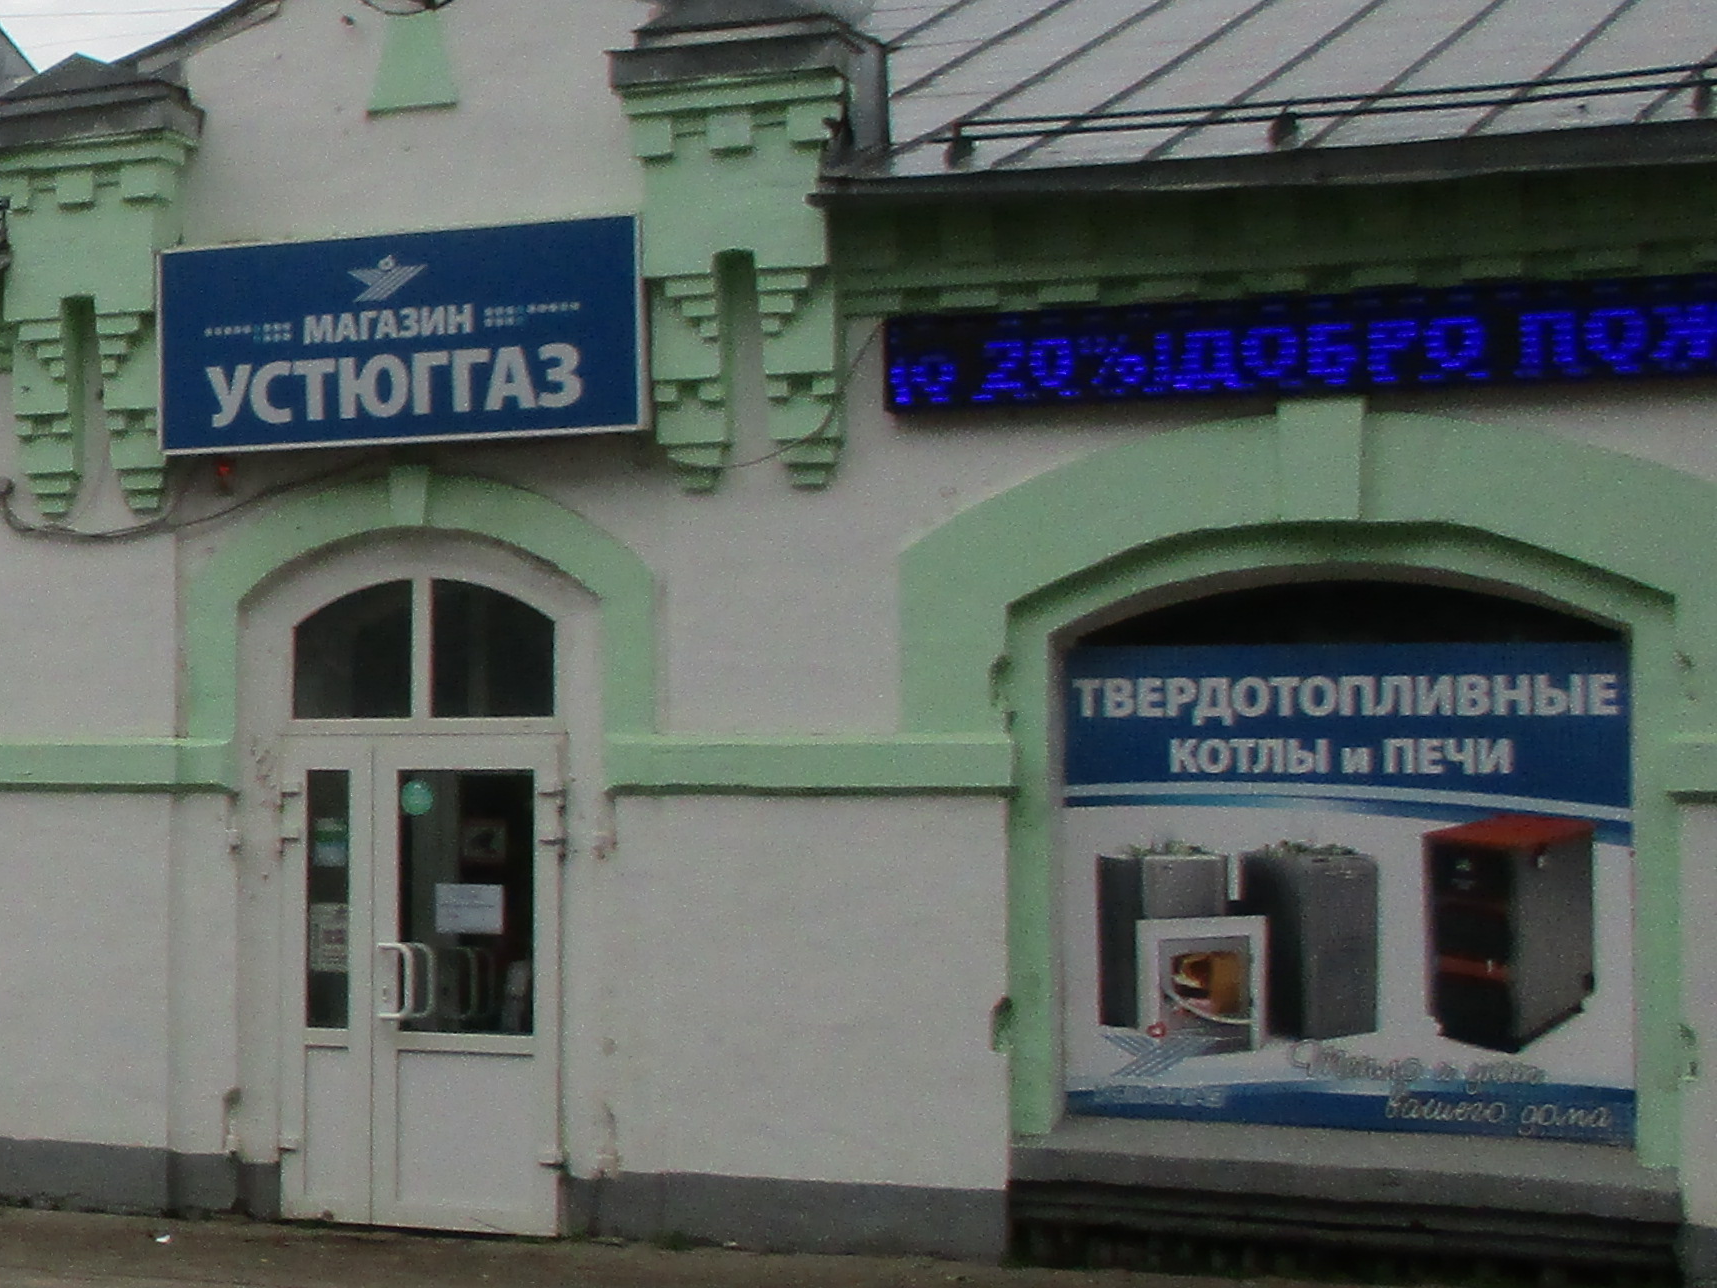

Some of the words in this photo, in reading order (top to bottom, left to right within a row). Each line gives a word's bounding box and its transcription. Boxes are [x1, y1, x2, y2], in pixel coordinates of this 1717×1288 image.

[303, 303, 475, 346] МАГАЗИН
[205, 342, 584, 429] УСТЮГГАЗ
[1072, 673, 1620, 726] ТВЕРДОТОПЛИВНЫЕ
[1169, 738, 1329, 776] КОТЛЫ
[1382, 738, 1514, 775] ПЕЧИ
[1384, 1085, 1507, 1125] вашего
[1518, 1100, 1611, 1138] дома
